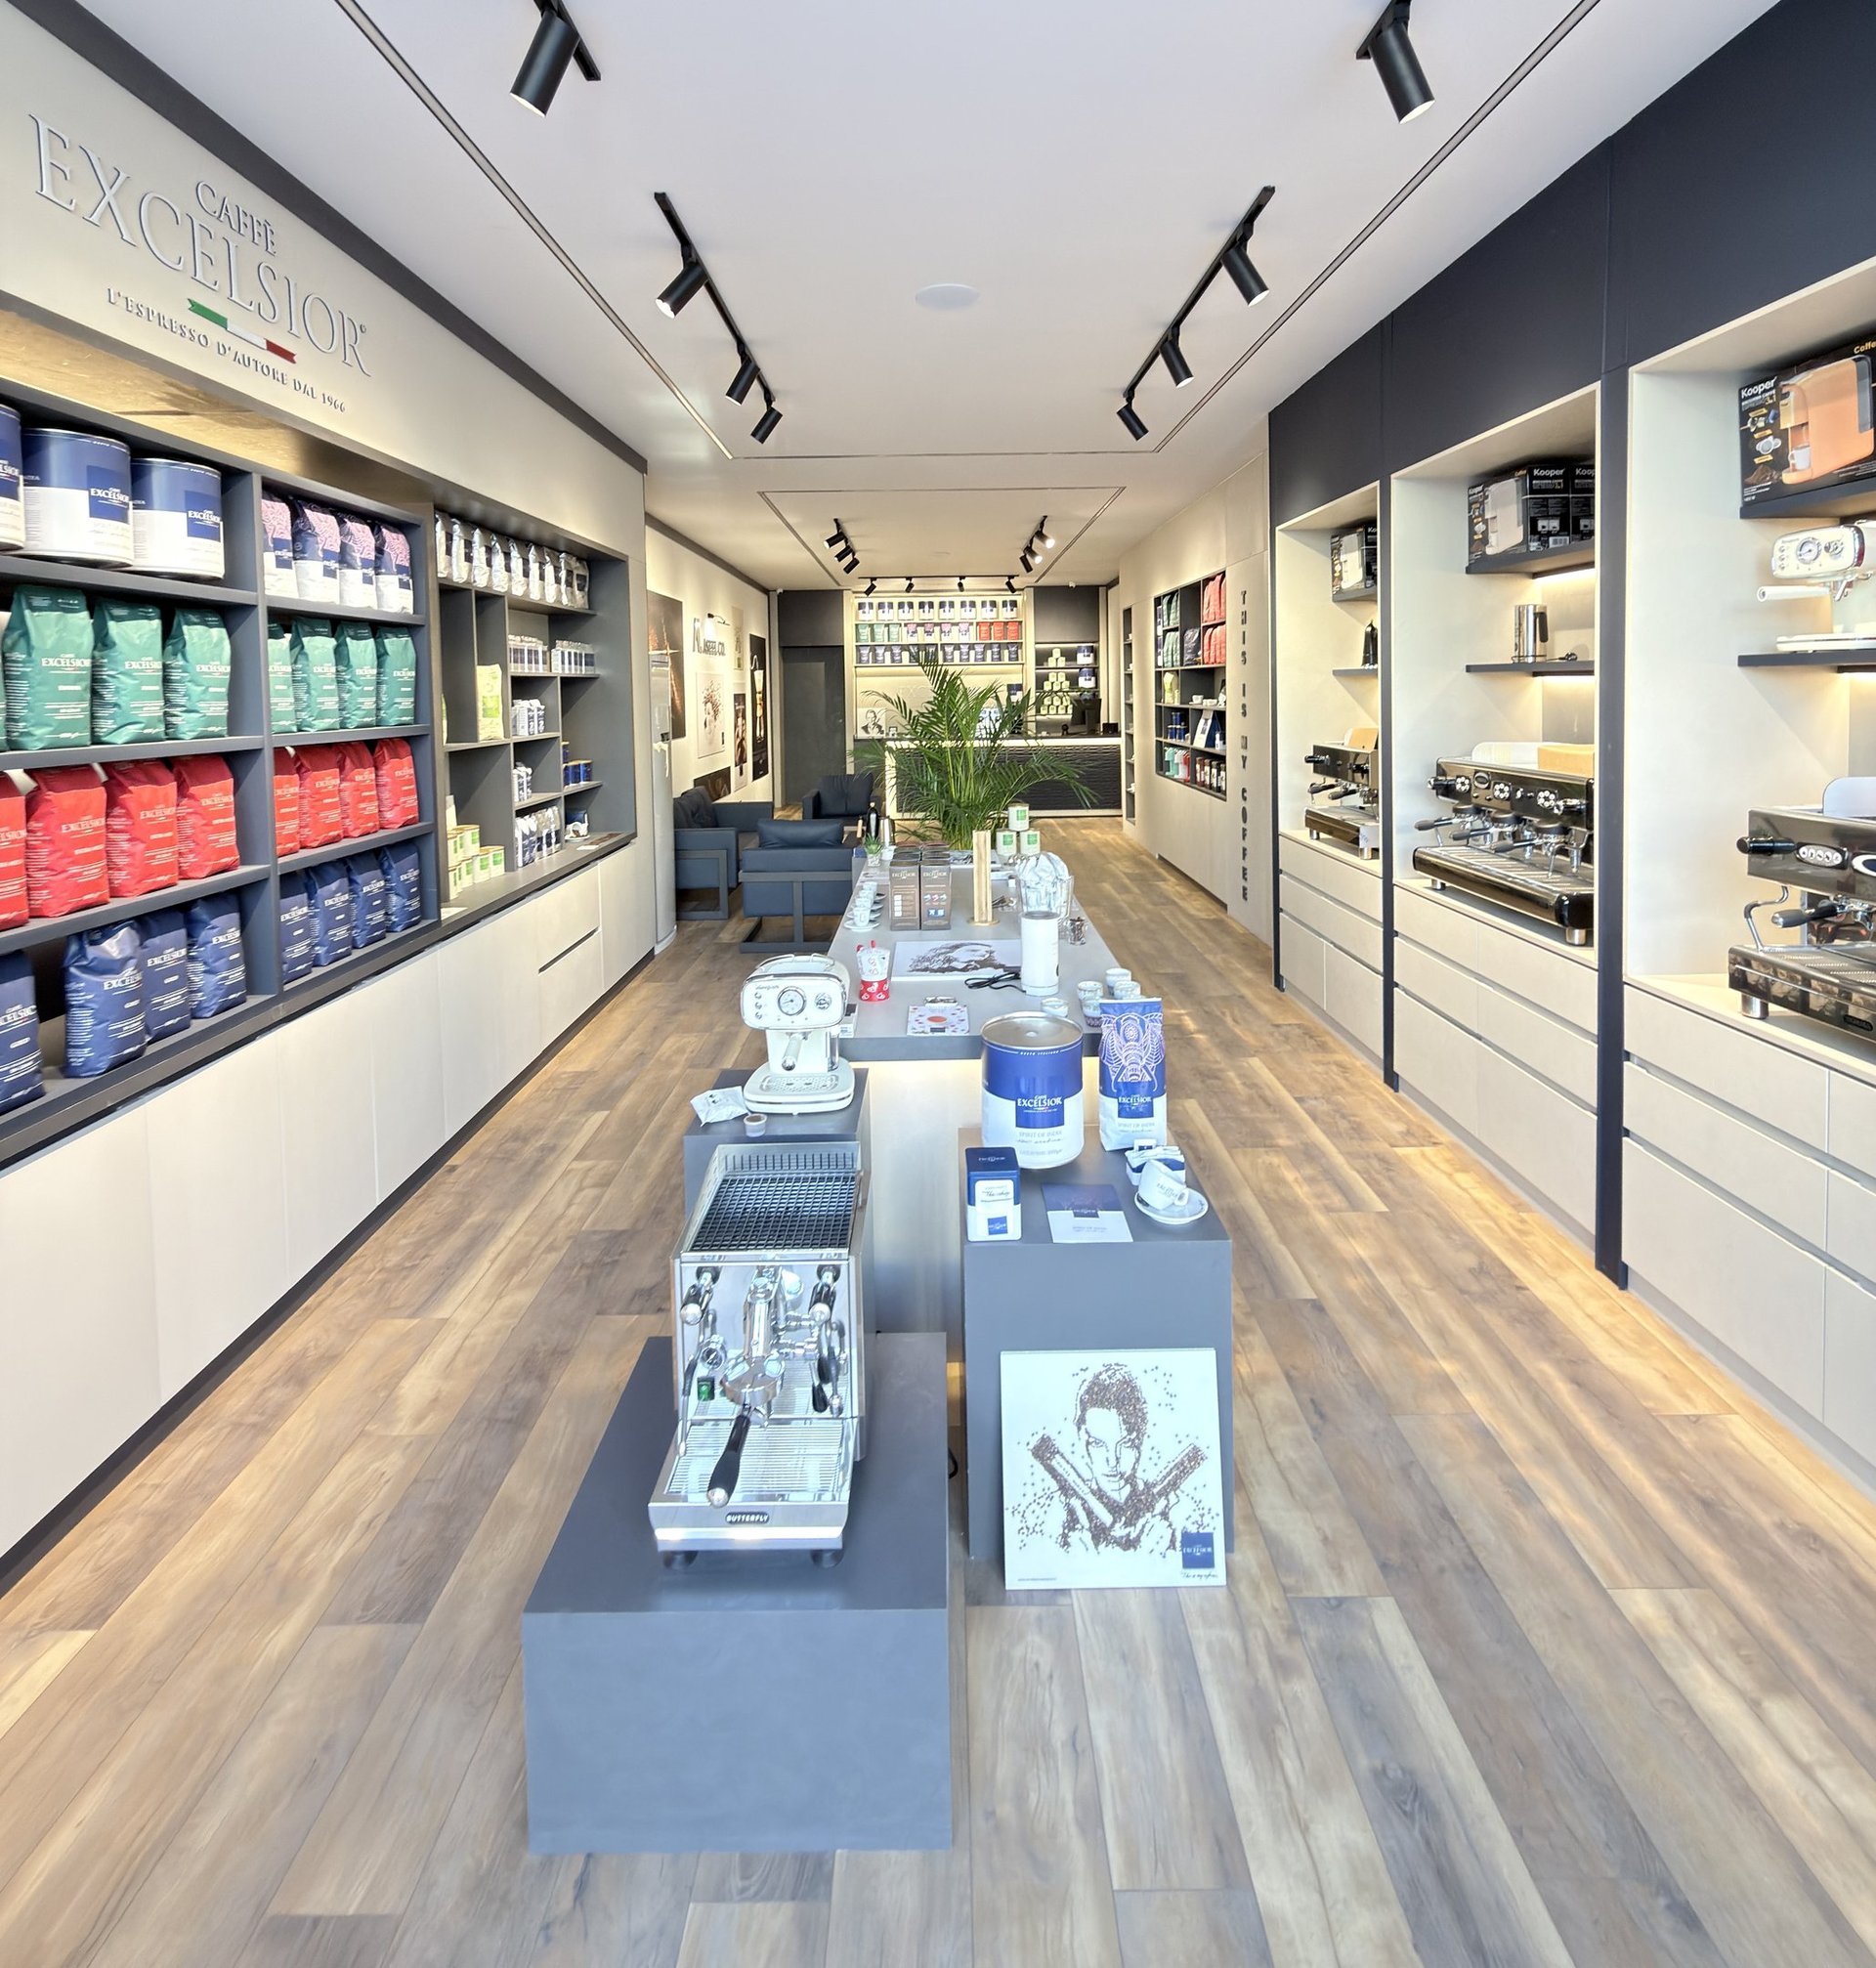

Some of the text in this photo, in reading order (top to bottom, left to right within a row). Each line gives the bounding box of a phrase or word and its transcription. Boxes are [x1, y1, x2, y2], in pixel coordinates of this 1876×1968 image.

[195, 180, 277, 257] CAFFÈ
[107, 287, 348, 414] L'ESPRESSO D'AUTORE DAL 1966
[1740, 376, 1778, 400] Kooper
[1533, 468, 1564, 478] Kooper
[1240, 682, 1248, 717] IS
[1016, 1095, 1063, 1108] EXCELSIOR
[1118, 1095, 1153, 1104] EXCELSIOR
